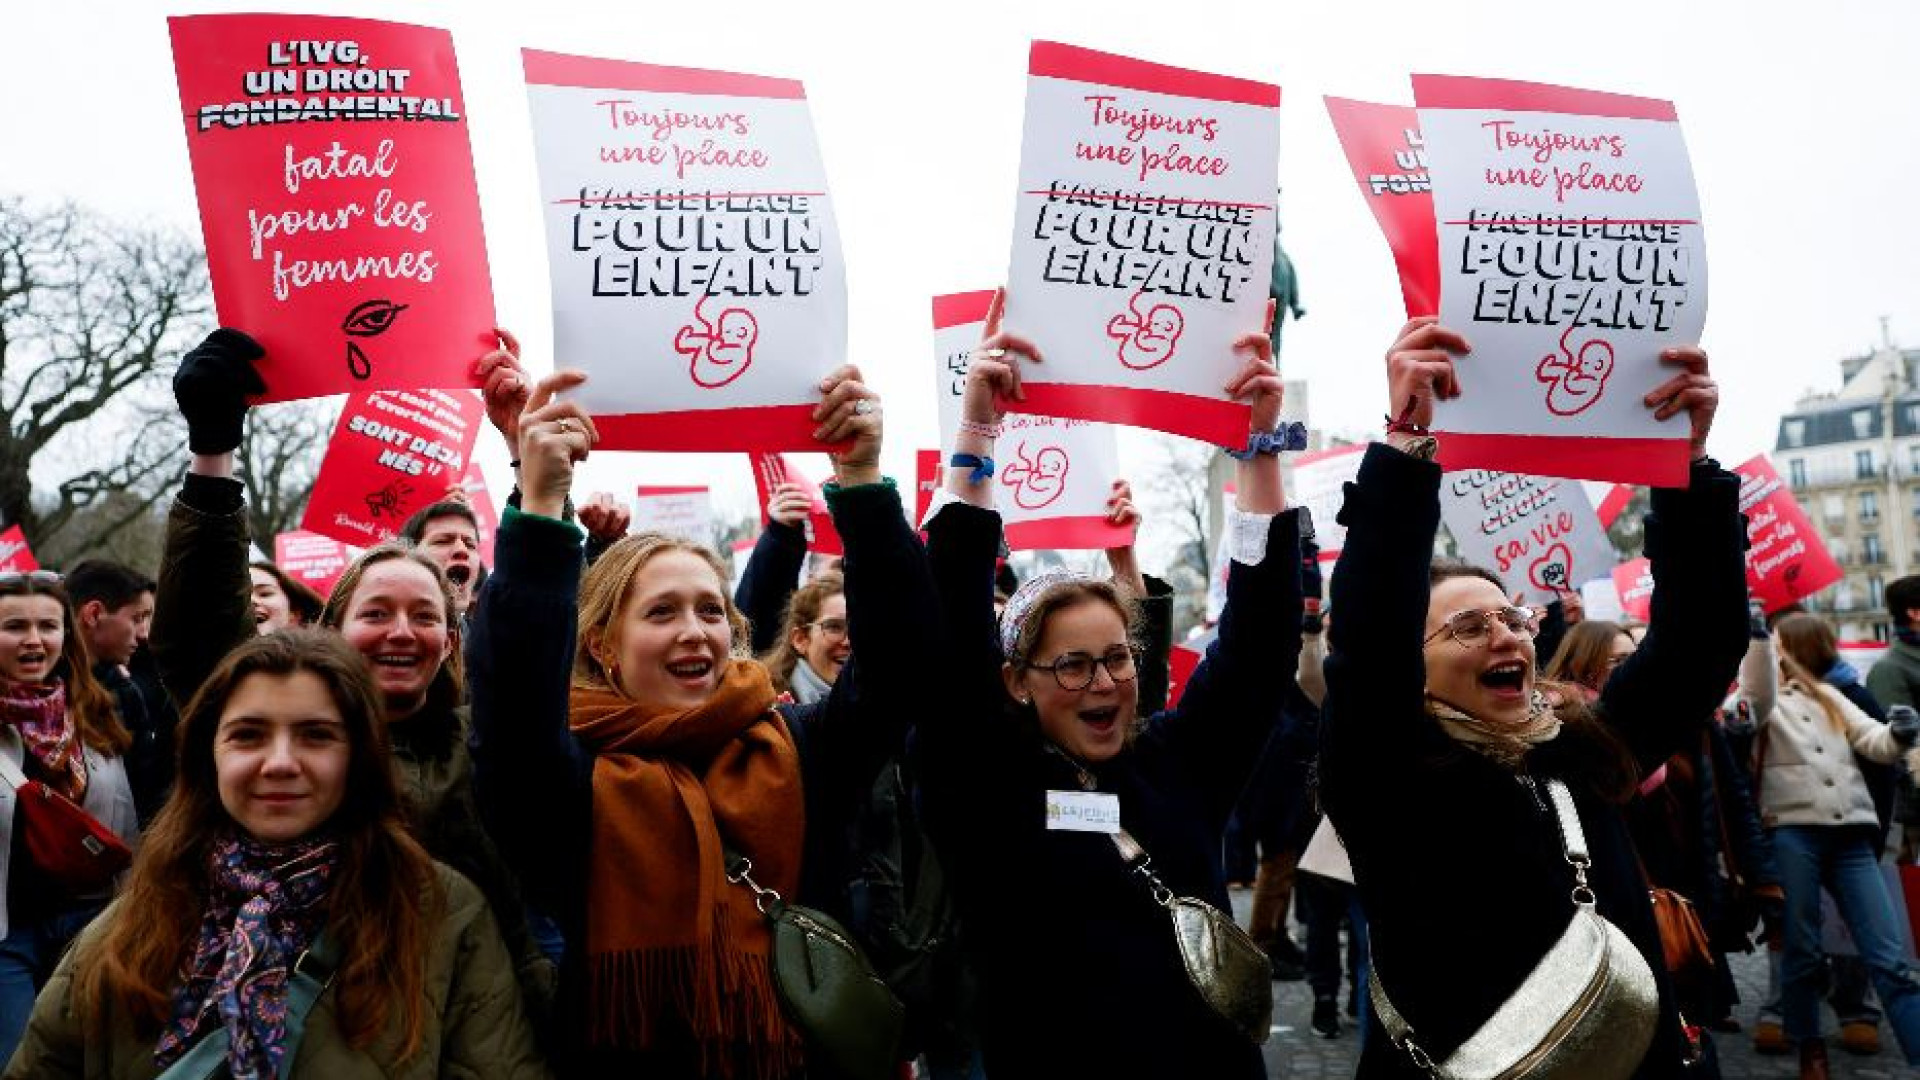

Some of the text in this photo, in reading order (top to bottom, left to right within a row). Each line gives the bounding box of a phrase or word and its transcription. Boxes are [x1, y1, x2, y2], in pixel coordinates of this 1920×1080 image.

[269, 40, 368, 67] L'IVG,
[244, 69, 410, 95] UN DROIT
[198, 96, 460, 131] FONDAMENTAL
[595, 99, 749, 140] Toujours
[1083, 95, 1219, 142] Toujours
[600, 139, 769, 179] une place
[1075, 141, 1229, 181] une place
[1481, 120, 1626, 163] Toujours
[284, 139, 398, 194] fatal
[1485, 162, 1644, 202] une place
[248, 189, 433, 260] pour les
[573, 213, 823, 253] POUR UN
[1034, 204, 1260, 266] POUR UN
[1468, 208, 1530, 236] PAS
[1580, 216, 1682, 244] PLACE
[273, 250, 439, 301] femmes
[592, 254, 823, 297] ENFANT
[1043, 245, 1254, 303] ENFANT
[1461, 235, 1691, 287] POUR UN
[1473, 277, 1688, 332] ENFANT
[349, 414, 412, 447] SONT
[1495, 510, 1573, 573] sa vie
